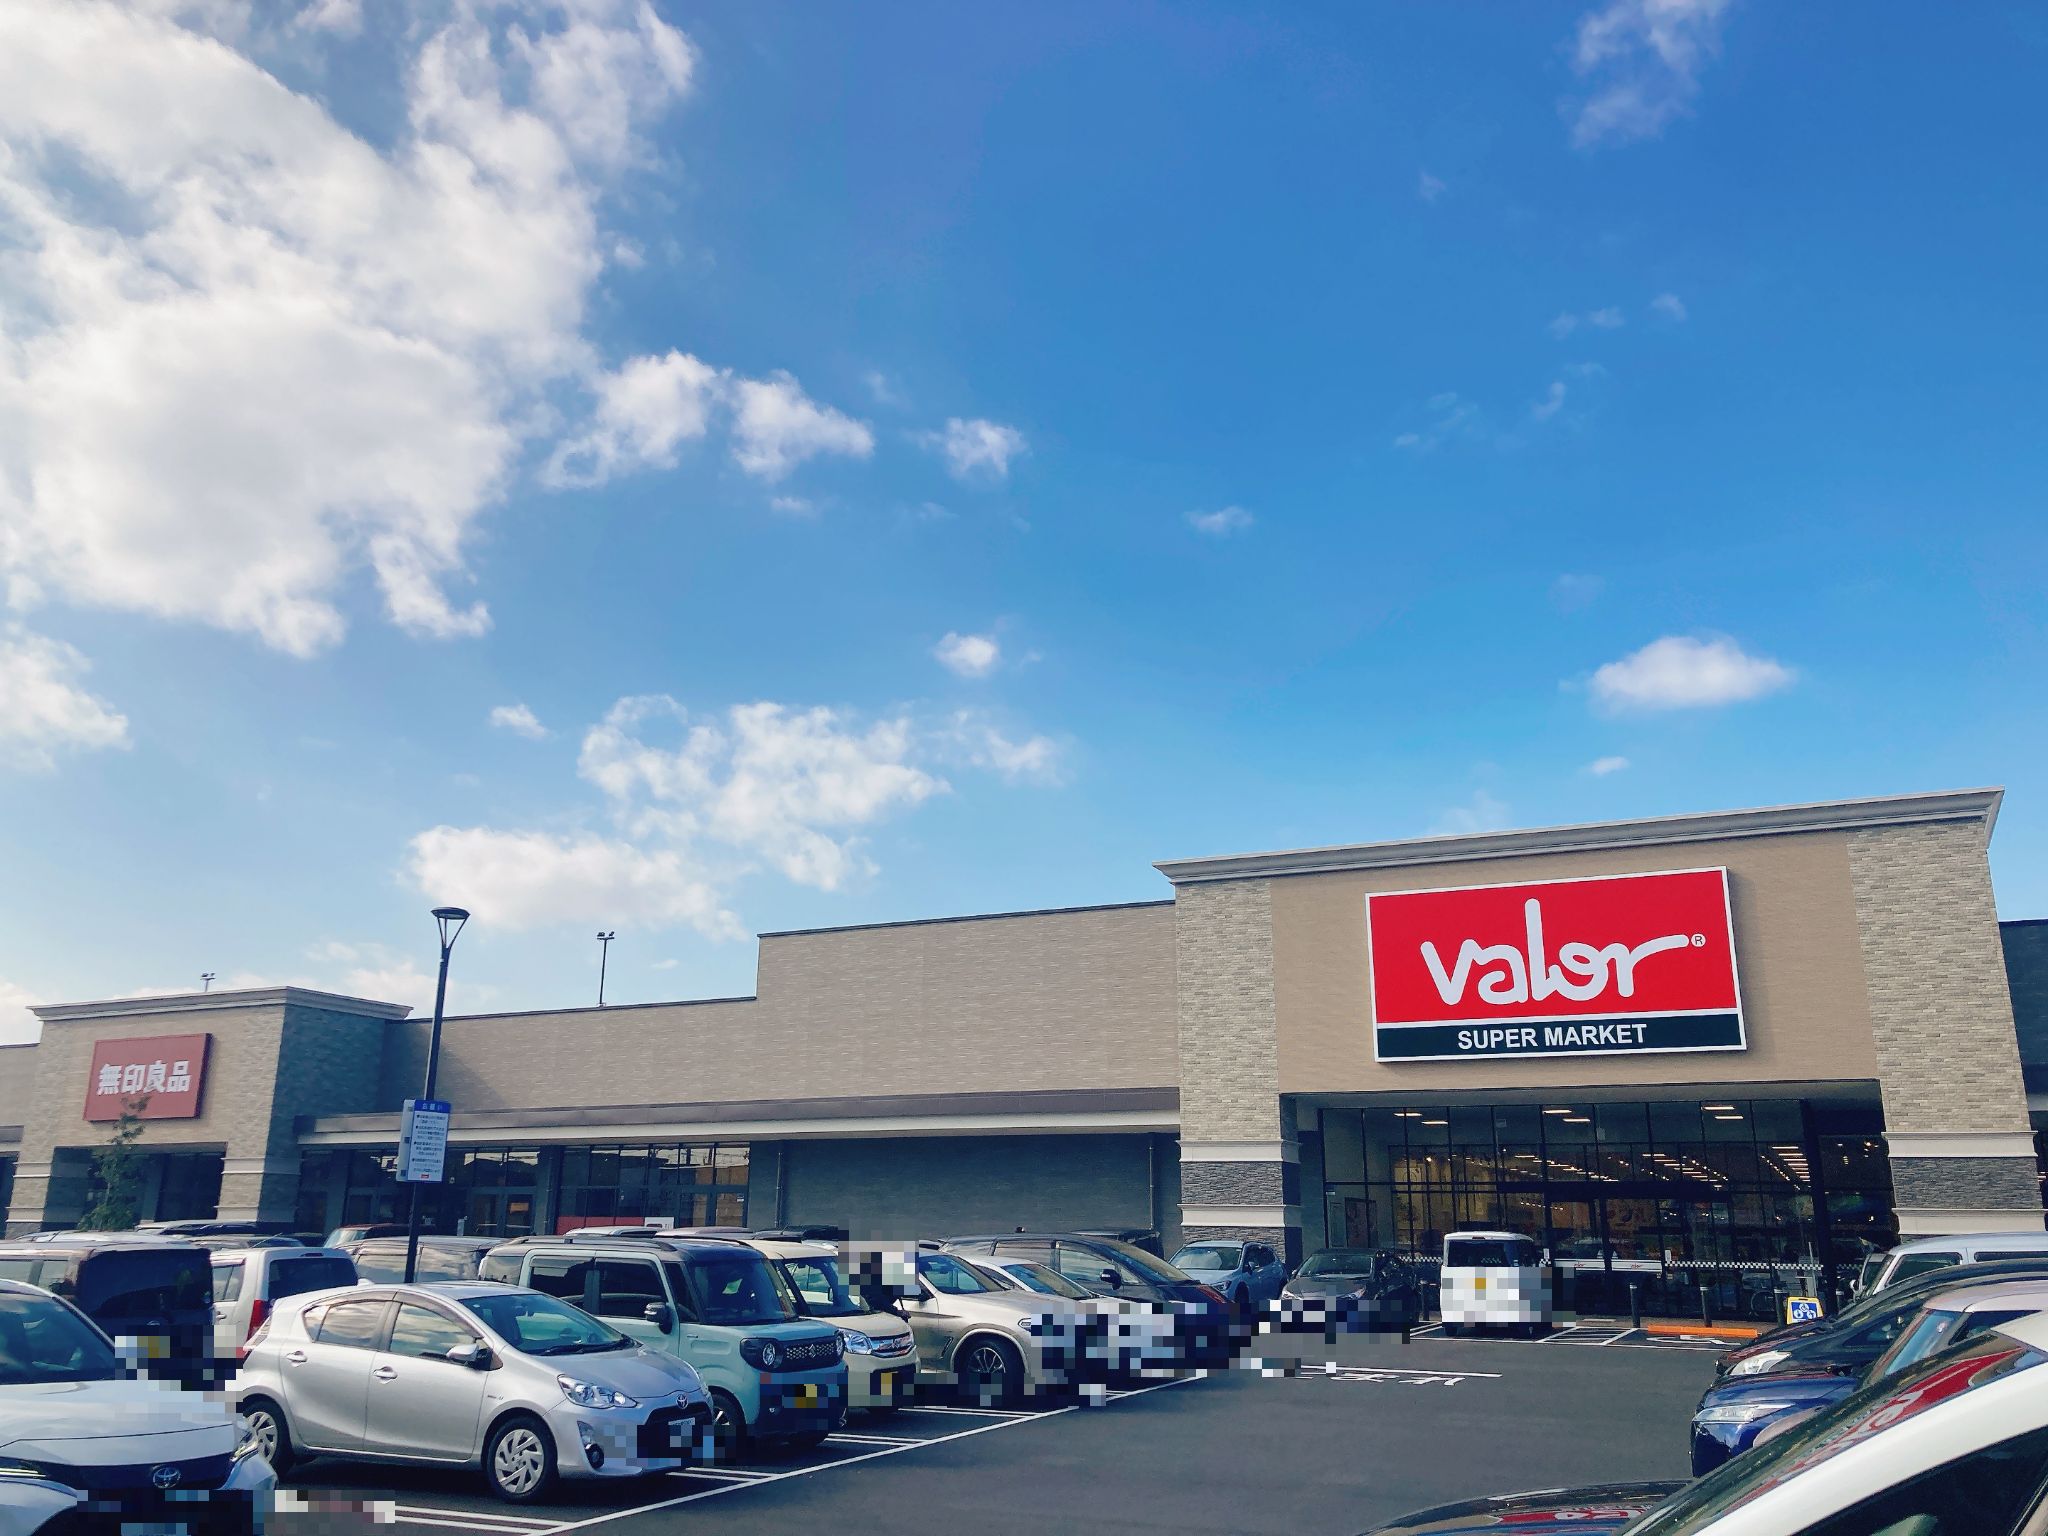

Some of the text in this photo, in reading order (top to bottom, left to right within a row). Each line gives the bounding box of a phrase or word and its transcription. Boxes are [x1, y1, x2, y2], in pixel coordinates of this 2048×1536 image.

[1457, 1023, 1648, 1050] SUPER MARKET
[97, 1060, 192, 1096] 無印良品
